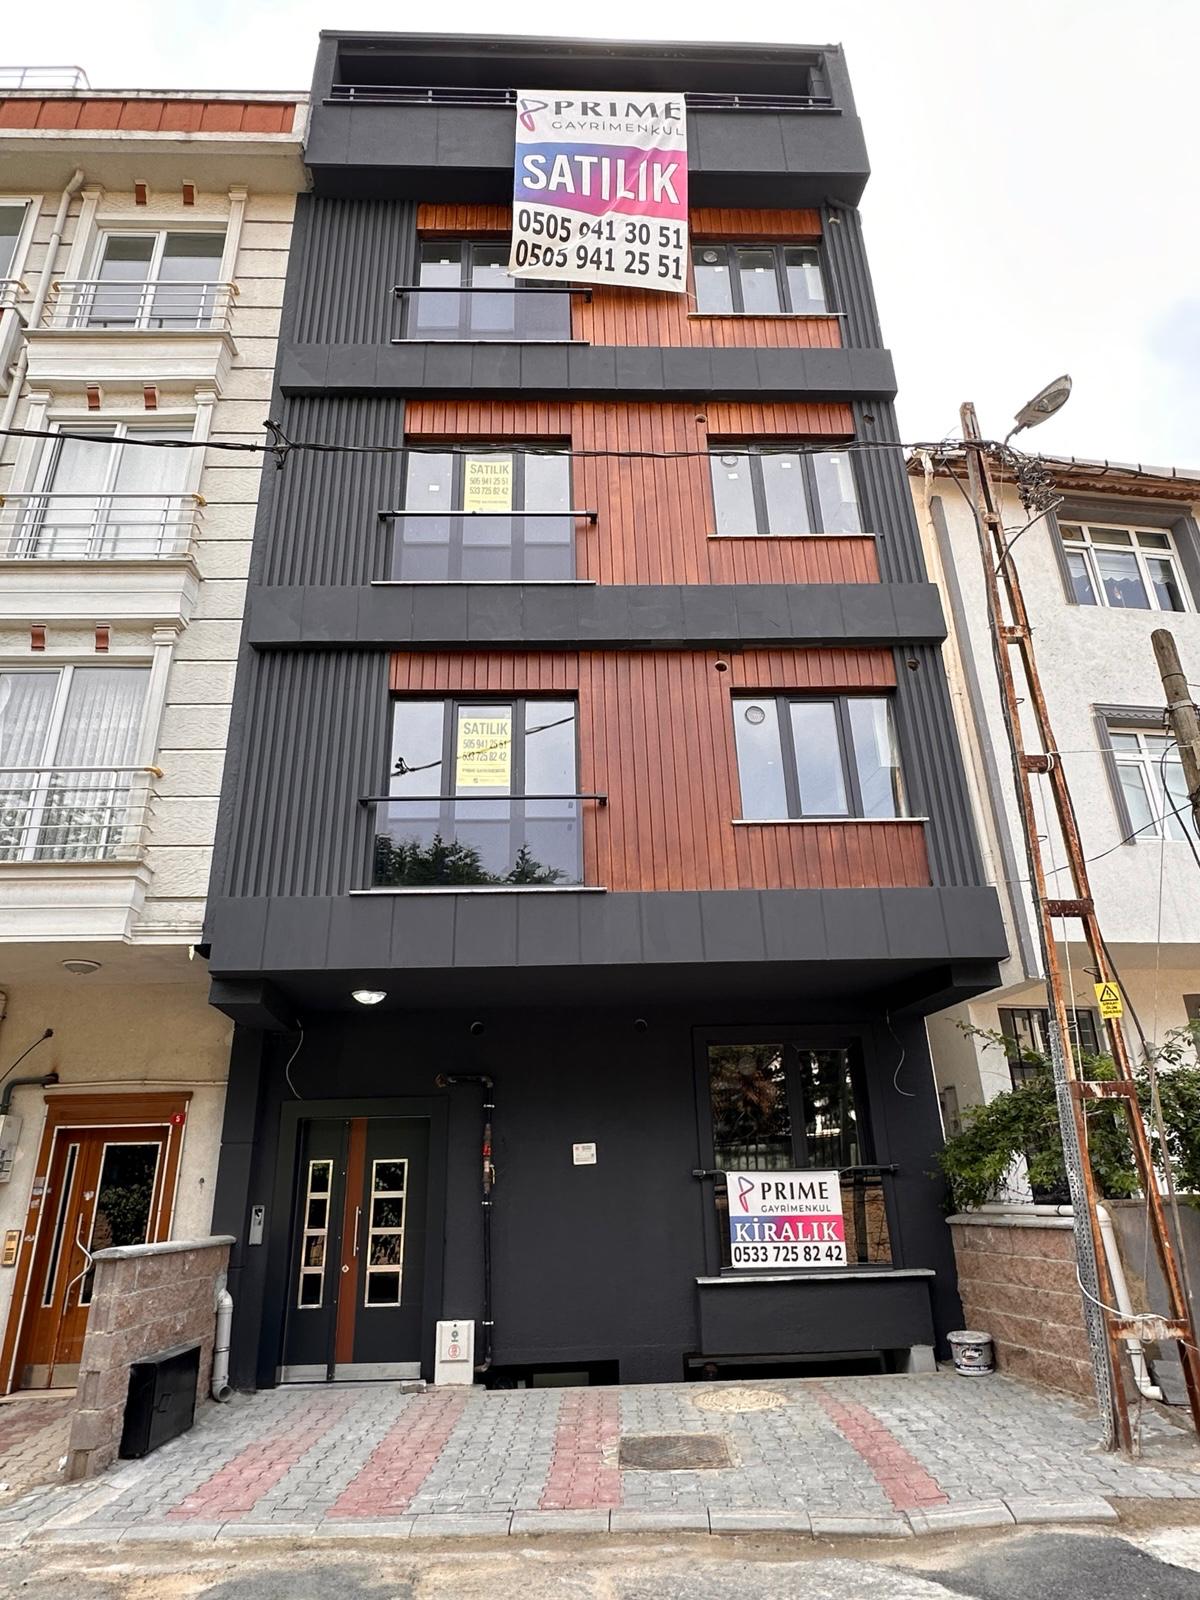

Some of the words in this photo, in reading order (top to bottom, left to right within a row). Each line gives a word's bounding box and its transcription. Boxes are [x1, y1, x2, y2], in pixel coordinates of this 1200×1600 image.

[554, 100, 681, 120] PRIME
[552, 120, 685, 136] GAYRİMENKUL
[522, 154, 681, 205] SATILIK
[518, 209, 572, 242] 0505
[578, 219, 616, 241] 941
[624, 222, 651, 245] 30
[658, 226, 683, 249] 51
[515, 239, 568, 267] 0505
[576, 245, 615, 272] 941
[624, 250, 650, 275] 25
[658, 255, 682, 280] 51
[470, 463, 510, 474] SATILIK
[463, 722, 508, 735] SATILIK
[761, 1182, 828, 1200] PRIME
[761, 1203, 832, 1213] GAYRİMENKUL
[734, 1217, 840, 1242] KİRALIK
[734, 1246, 768, 1262] 0533
[773, 1246, 799, 1262] 725
[803, 1245, 821, 1261] 82
[825, 1245, 843, 1261] 42
